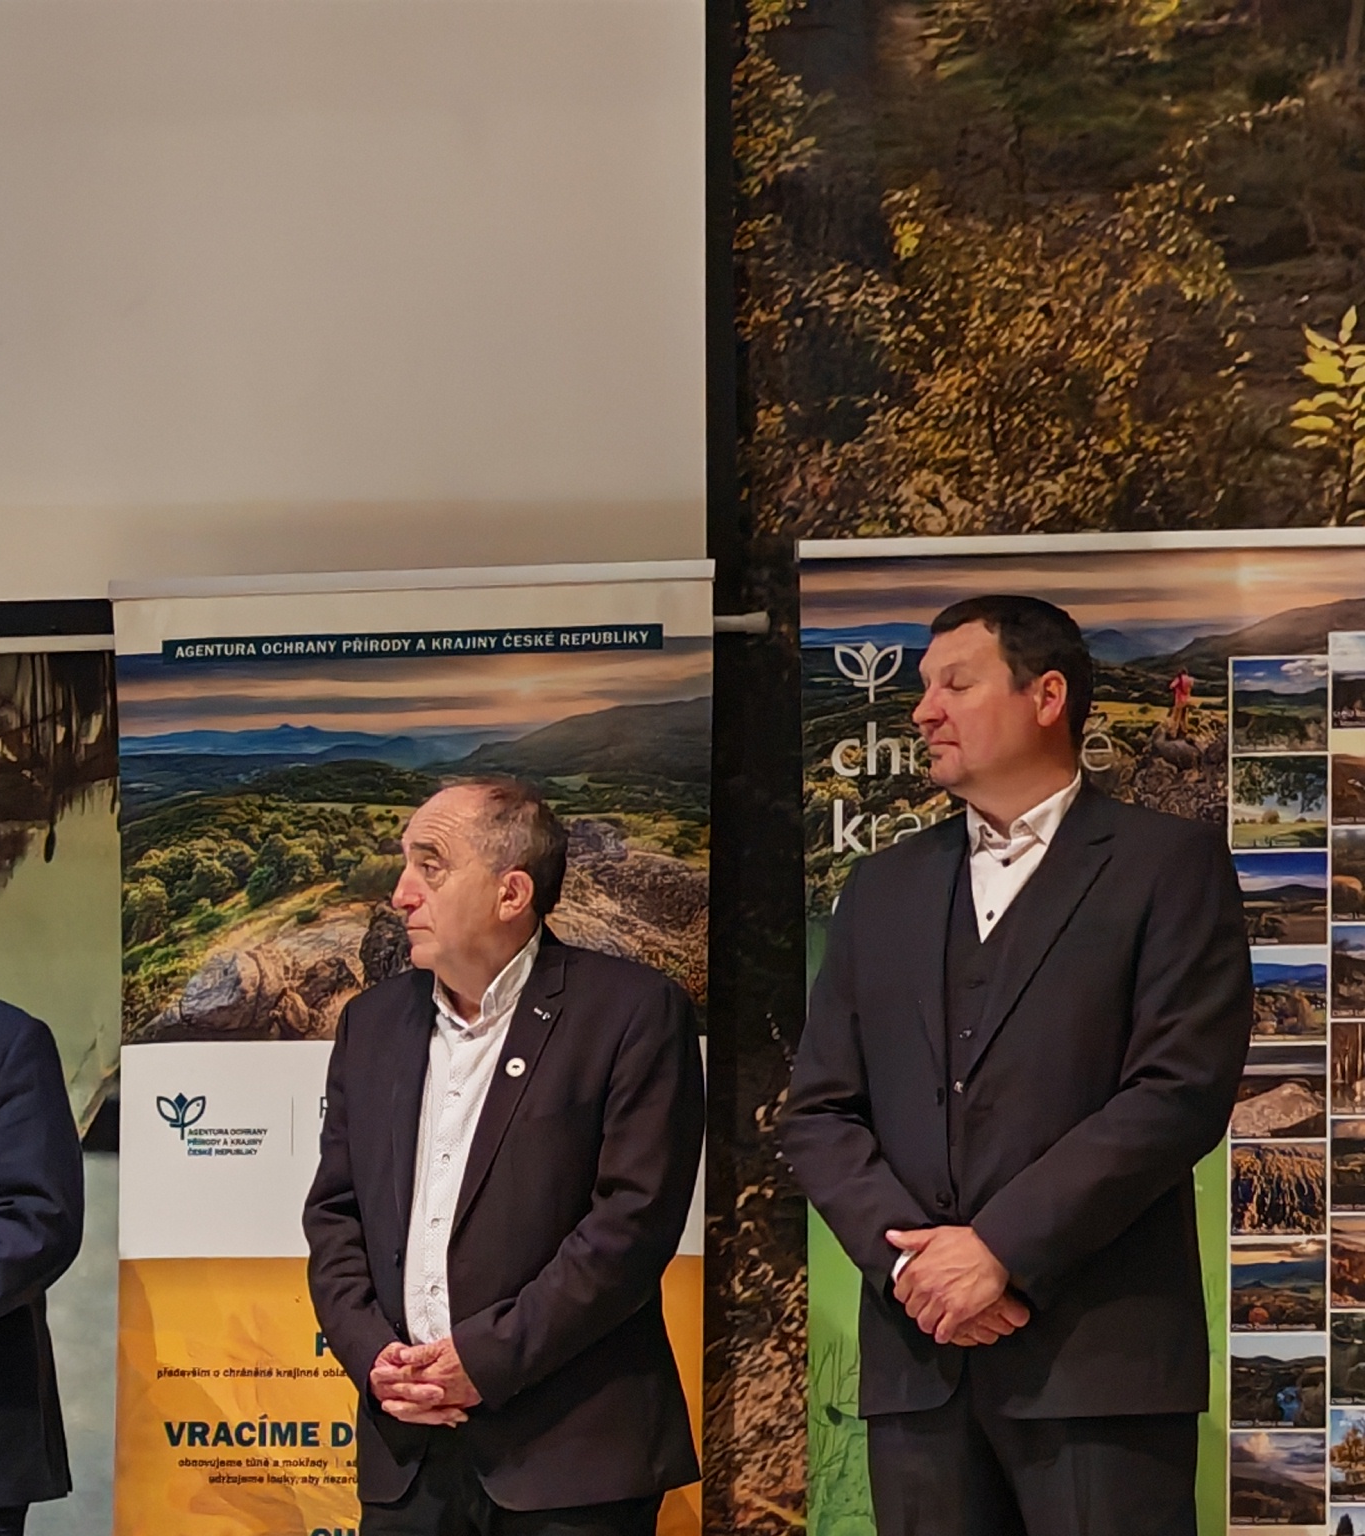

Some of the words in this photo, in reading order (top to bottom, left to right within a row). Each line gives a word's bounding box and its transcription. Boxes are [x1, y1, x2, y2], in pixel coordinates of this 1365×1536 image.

[175, 642, 257, 658] AGENTURA
[261, 639, 338, 656] OCHRANY
[342, 636, 412, 653] PŘÍRODY
[415, 637, 426, 651] A
[431, 635, 499, 650] KRAJINY
[502, 630, 556, 648] ČESKÉ
[559, 630, 649, 647] REPUBLIKY
[164, 1414, 320, 1447] VRACÍME
